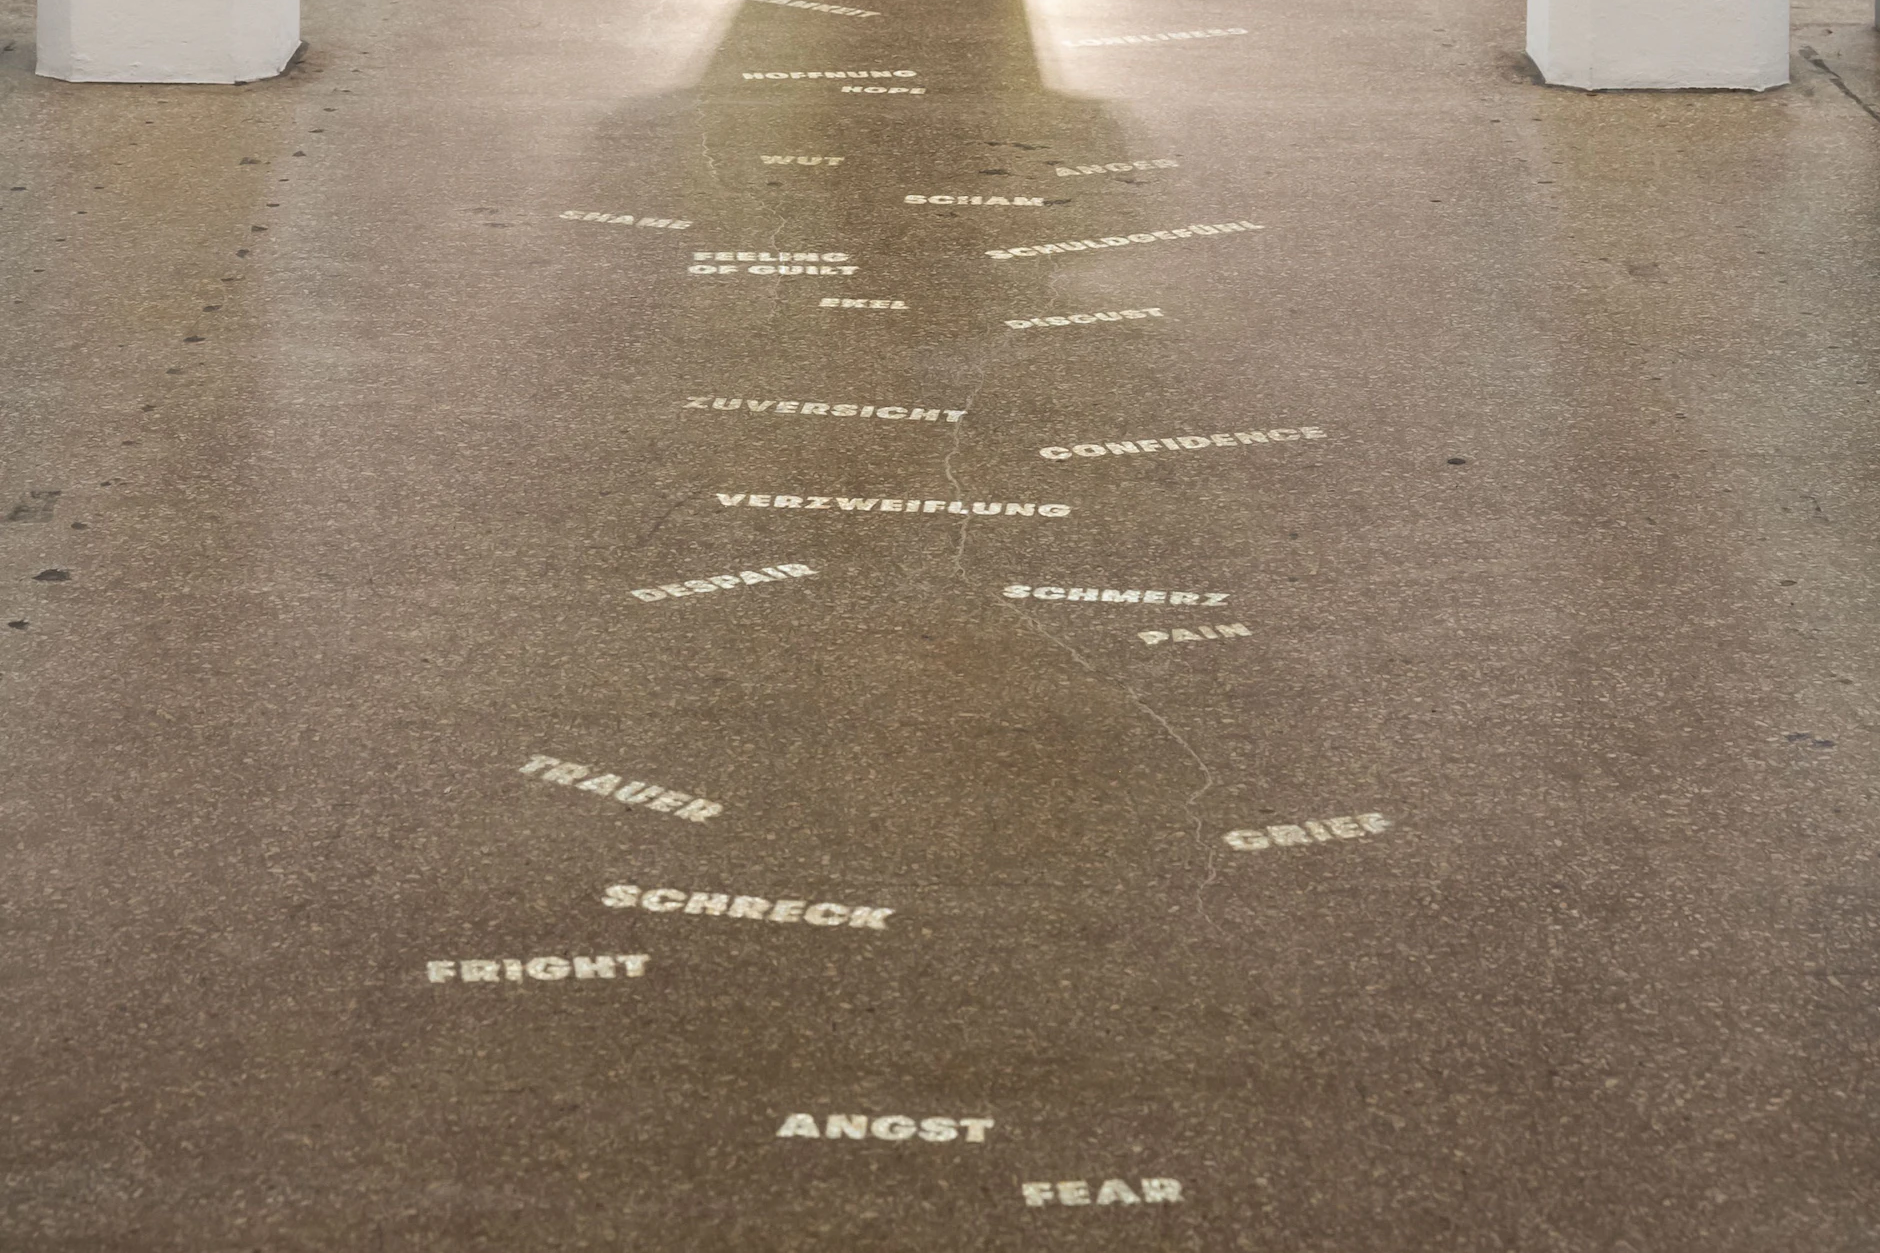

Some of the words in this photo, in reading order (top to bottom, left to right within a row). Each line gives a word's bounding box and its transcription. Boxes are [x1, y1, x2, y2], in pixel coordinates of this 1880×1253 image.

[742, 69, 918, 80] HOFFNUNG
[841, 85, 927, 96] HOPE
[761, 154, 845, 167] WUT
[1054, 158, 1179, 177] ANGER
[904, 194, 1045, 207] SCHAM
[558, 210, 693, 230] SHAME
[985, 220, 1265, 260] SCHULDGEFÜHL
[693, 251, 851, 263] FEELING
[688, 264, 738, 276] OF
[747, 264, 860, 277] GUILT
[818, 297, 909, 310] EKEL
[1004, 307, 1164, 330] DISGUST
[682, 396, 968, 423] ZUVERSICHT
[1040, 426, 1328, 461] CONFIDENCE
[715, 492, 1073, 518] VERZWEIFLUNG
[631, 562, 817, 604] DESPAIR
[1002, 584, 1230, 608] SCHMERZ
[1139, 622, 1253, 646] PAIN
[519, 753, 724, 824] TRAUER
[1222, 811, 1394, 851] GRIEF
[602, 884, 896, 931] SCHRECK
[426, 954, 651, 984] FRIGHT
[776, 1113, 995, 1143] ANGST
[1022, 1178, 1184, 1207] FEAR
